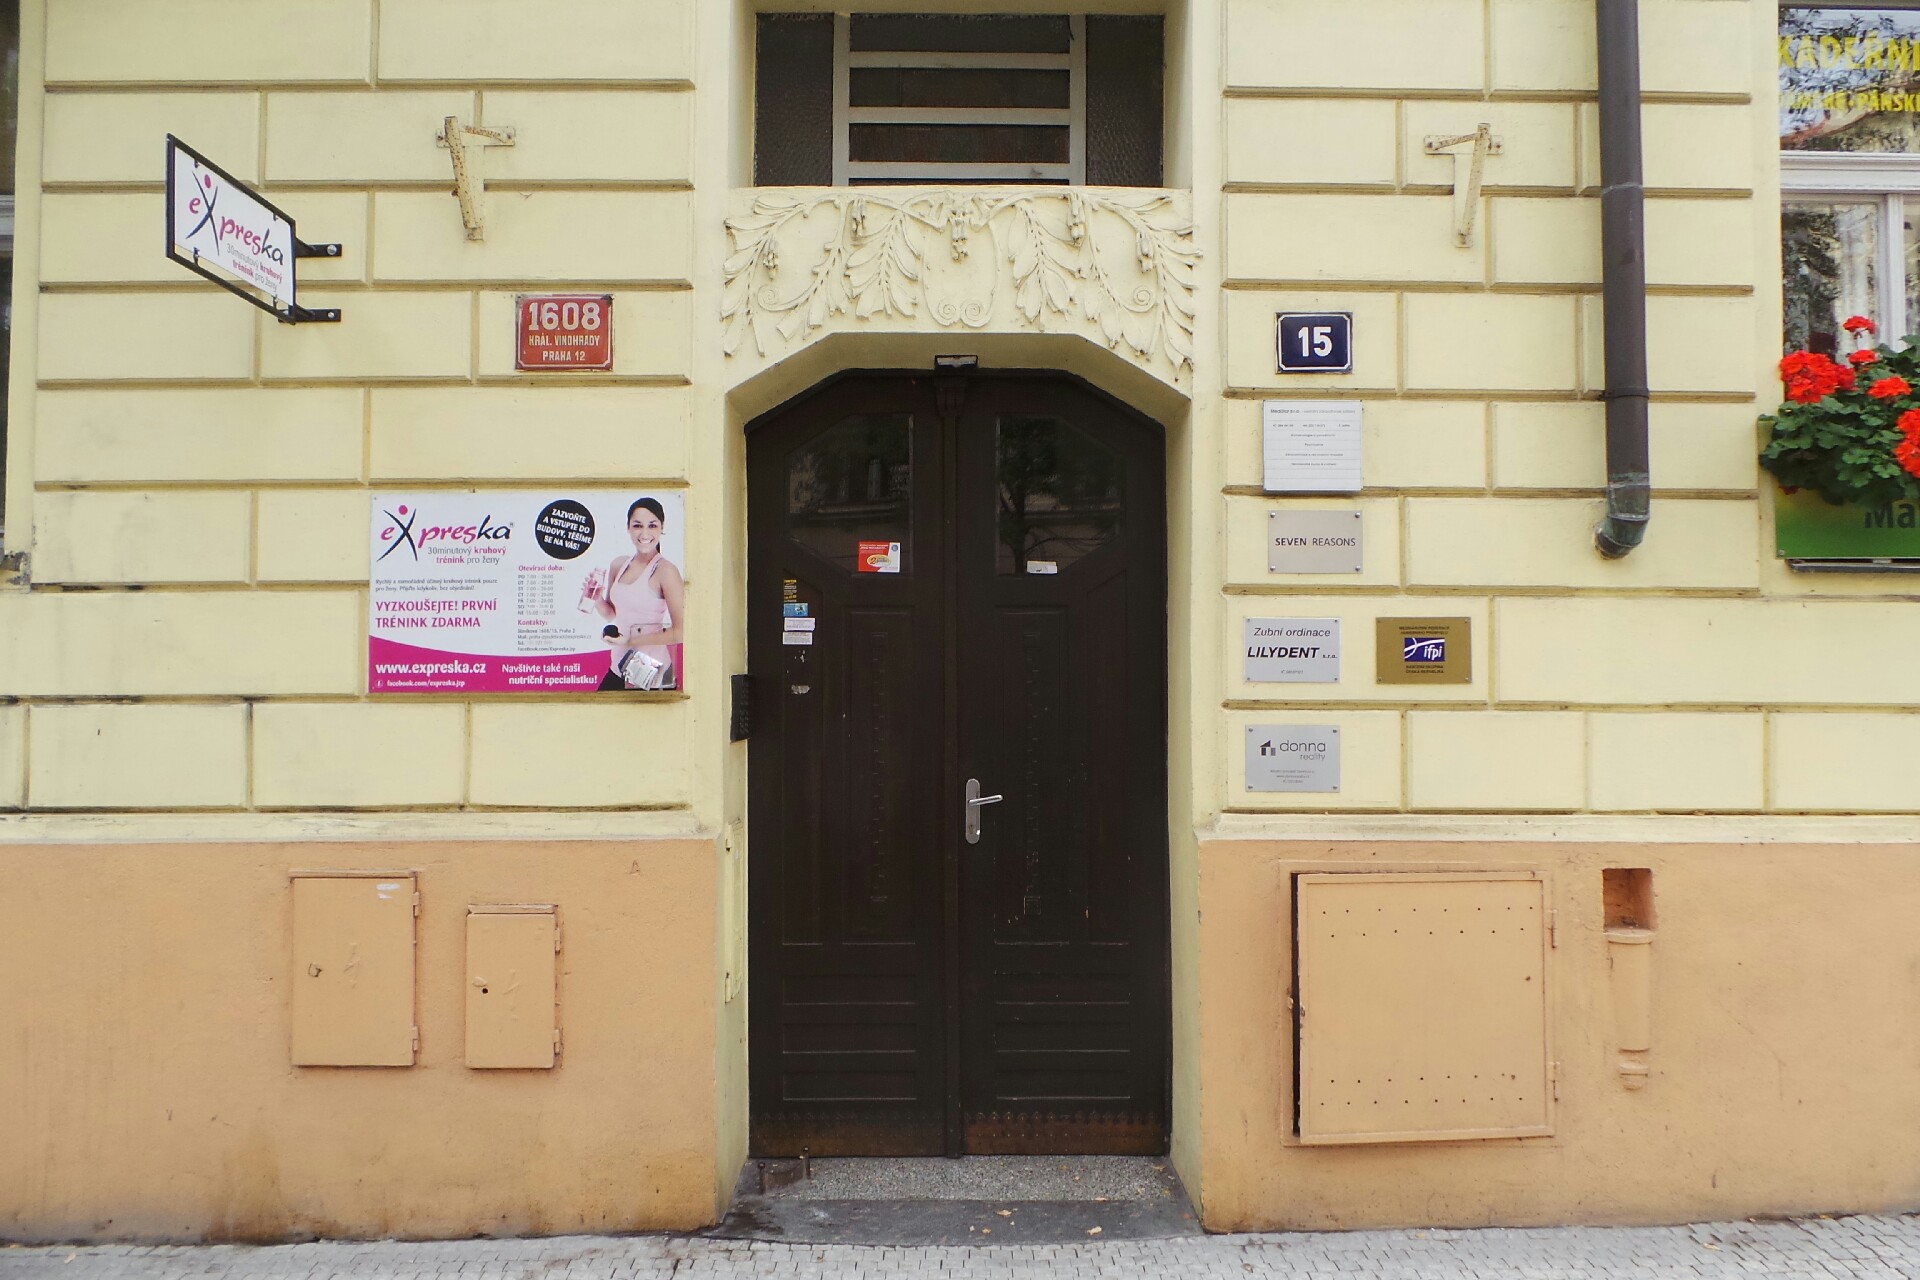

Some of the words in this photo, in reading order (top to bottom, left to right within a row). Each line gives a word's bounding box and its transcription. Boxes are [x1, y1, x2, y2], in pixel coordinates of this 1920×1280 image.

[529, 302, 601, 330] 1608
[529, 333, 552, 346] KRÁL.
[555, 335, 600, 346] VINOHRADY
[1298, 326, 1333, 357] 15
[543, 351, 572, 361] PRAHA
[575, 351, 586, 361] 12
[552, 508, 587, 524] ZAZVOŇTE
[543, 516, 549, 524] A
[550, 517, 579, 531] VSTUPTE
[579, 525, 590, 534] DO
[536, 523, 566, 539] BUDOVY,
[568, 531, 593, 544] TĚŠÍME
[544, 535, 553, 544] SE
[553, 537, 564, 547] NA
[565, 540, 581, 551] VÁS!
[1275, 537, 1307, 546] SEVEN
[1312, 537, 1356, 547] REASONS
[427, 546, 473, 556] 30minutový
[474, 546, 507, 556] kruhový
[436, 556, 465, 564] trénink
[467, 558, 480, 566] pro
[482, 555, 500, 565] ženy
[376, 599, 458, 614] VYZKOUŠEJTE!
[462, 598, 498, 611] PRVNÍ
[375, 615, 428, 628] TRÉNINK
[431, 617, 481, 628] ZDARMA
[1253, 627, 1284, 637] Zubní
[1285, 627, 1331, 637] ordinace
[1247, 647, 1320, 659] LILYDENT
[1423, 645, 1443, 661] ifpi
[375, 660, 486, 677] www.expreska.cz
[543, 663, 561, 673] také
[563, 663, 580, 673] naši
[509, 675, 543, 684] nutriční
[544, 675, 598, 686] specialistku!
[1279, 740, 1326, 752] donna
[1300, 753, 1326, 761] reality
